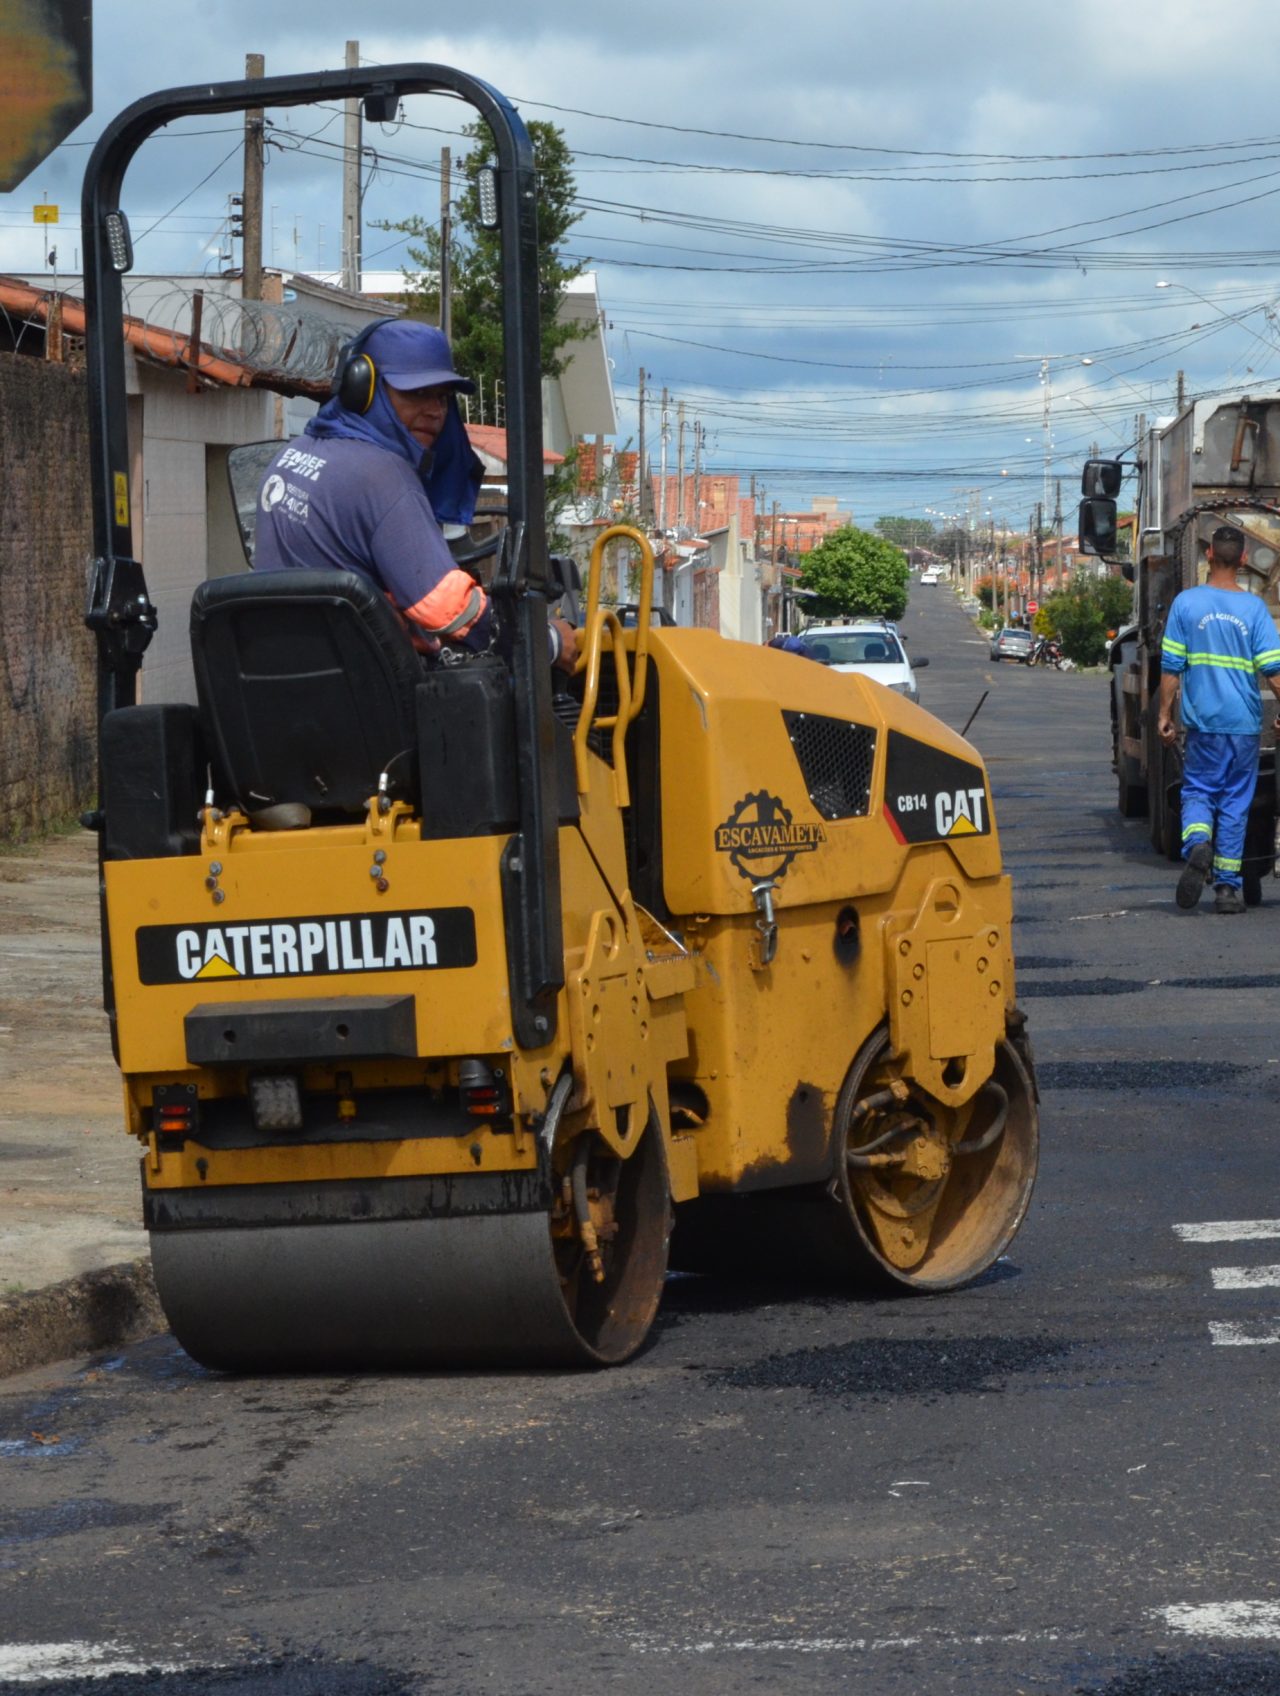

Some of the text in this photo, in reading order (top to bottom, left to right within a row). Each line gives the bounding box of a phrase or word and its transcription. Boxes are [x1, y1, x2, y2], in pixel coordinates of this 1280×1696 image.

[718, 823, 827, 848] ESCAVAMETA
[897, 788, 985, 836] CB14 CAT
[175, 916, 438, 979] CATERPILLAR
